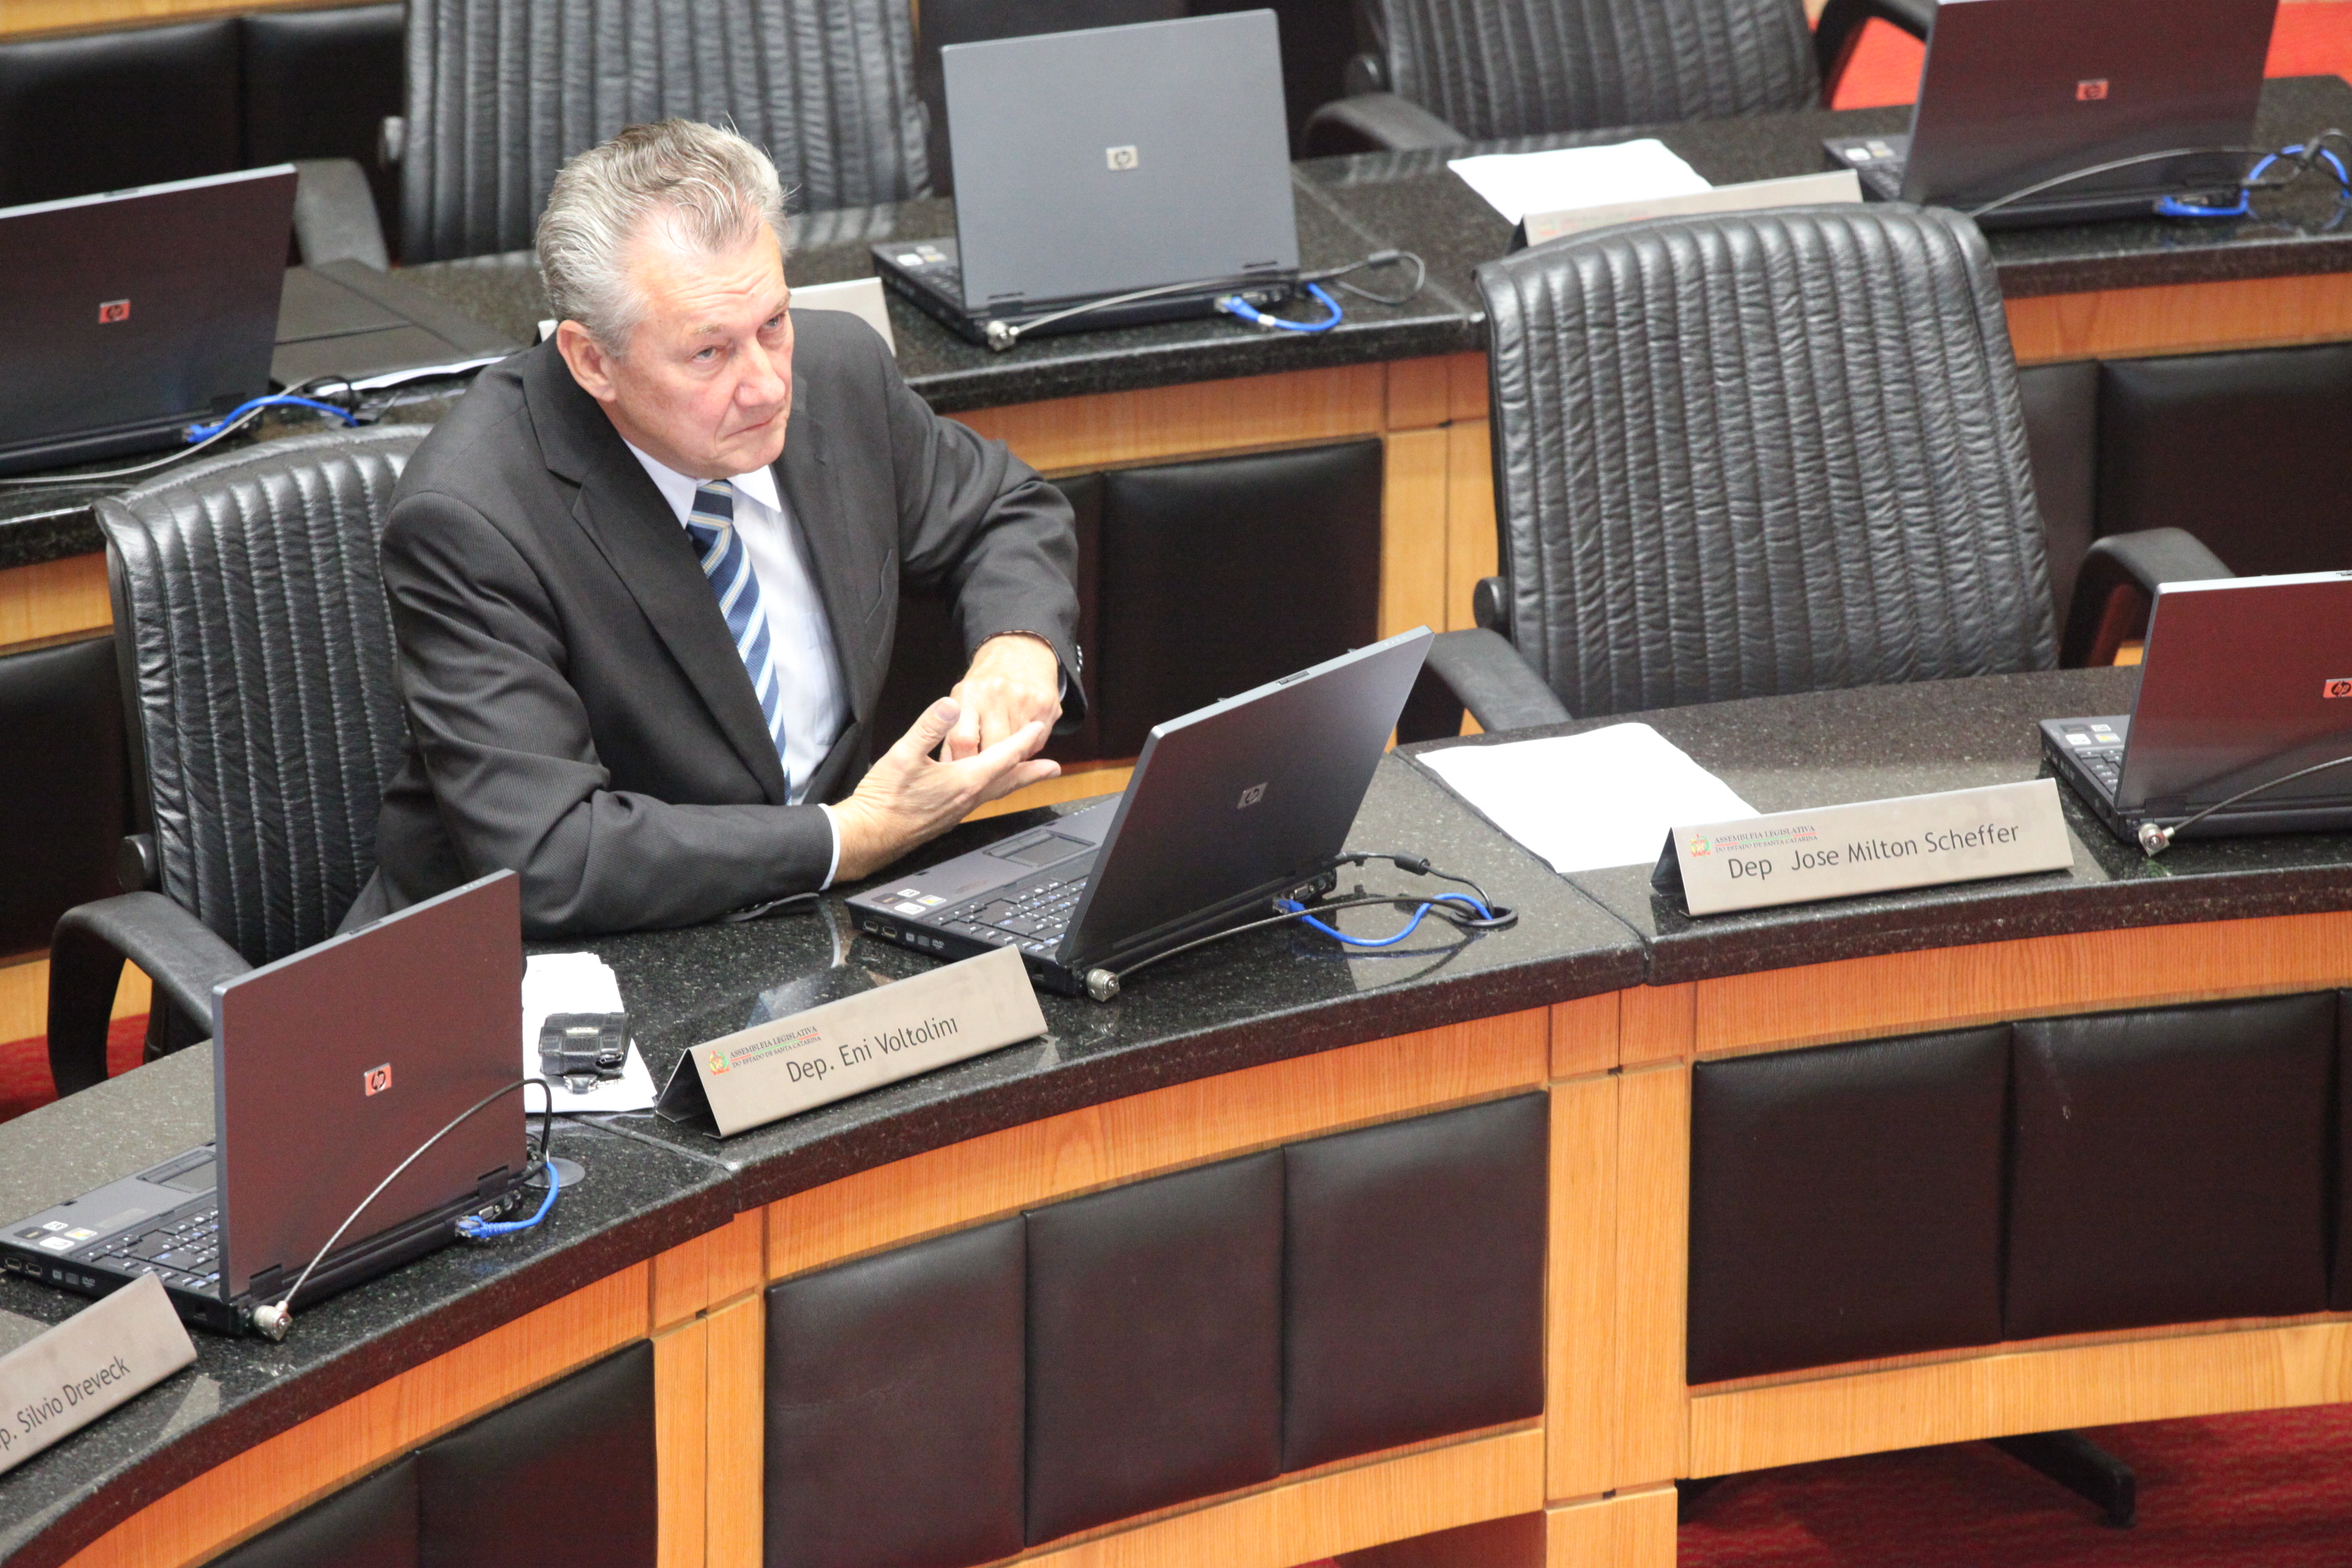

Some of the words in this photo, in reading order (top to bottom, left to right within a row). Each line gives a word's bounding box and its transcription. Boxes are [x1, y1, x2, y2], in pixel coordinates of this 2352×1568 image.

[1714, 830, 1764, 845] ASSEMBLEIA
[1765, 825, 1816, 838] LEGISLATIVA
[1727, 842, 1753, 852] ESTADO
[1763, 839, 1784, 847] SANTA
[1785, 835, 1818, 845] CATARINA
[1728, 858, 1772, 880] Dep
[1791, 848, 1840, 872] Jose
[1848, 836, 1918, 864] Milton
[1925, 823, 2020, 853] Scheffer
[730, 1039, 773, 1059] ASSEMBLEIA
[772, 1026, 818, 1048] LEGISLATIVA
[732, 1059, 743, 1068] DO
[743, 1054, 765, 1065] ESTADO
[765, 1050, 774, 1059] DE
[774, 1045, 792, 1056] SANTA
[792, 1035, 822, 1049] CATARINA
[786, 1058, 835, 1082] Dep.
[839, 1038, 872, 1067] Eni
[874, 1016, 959, 1055] Voltolini
[0, 1429, 17, 1451] p.
[17, 1396, 63, 1433] Silvio
[62, 1356, 131, 1406] Dreveck
